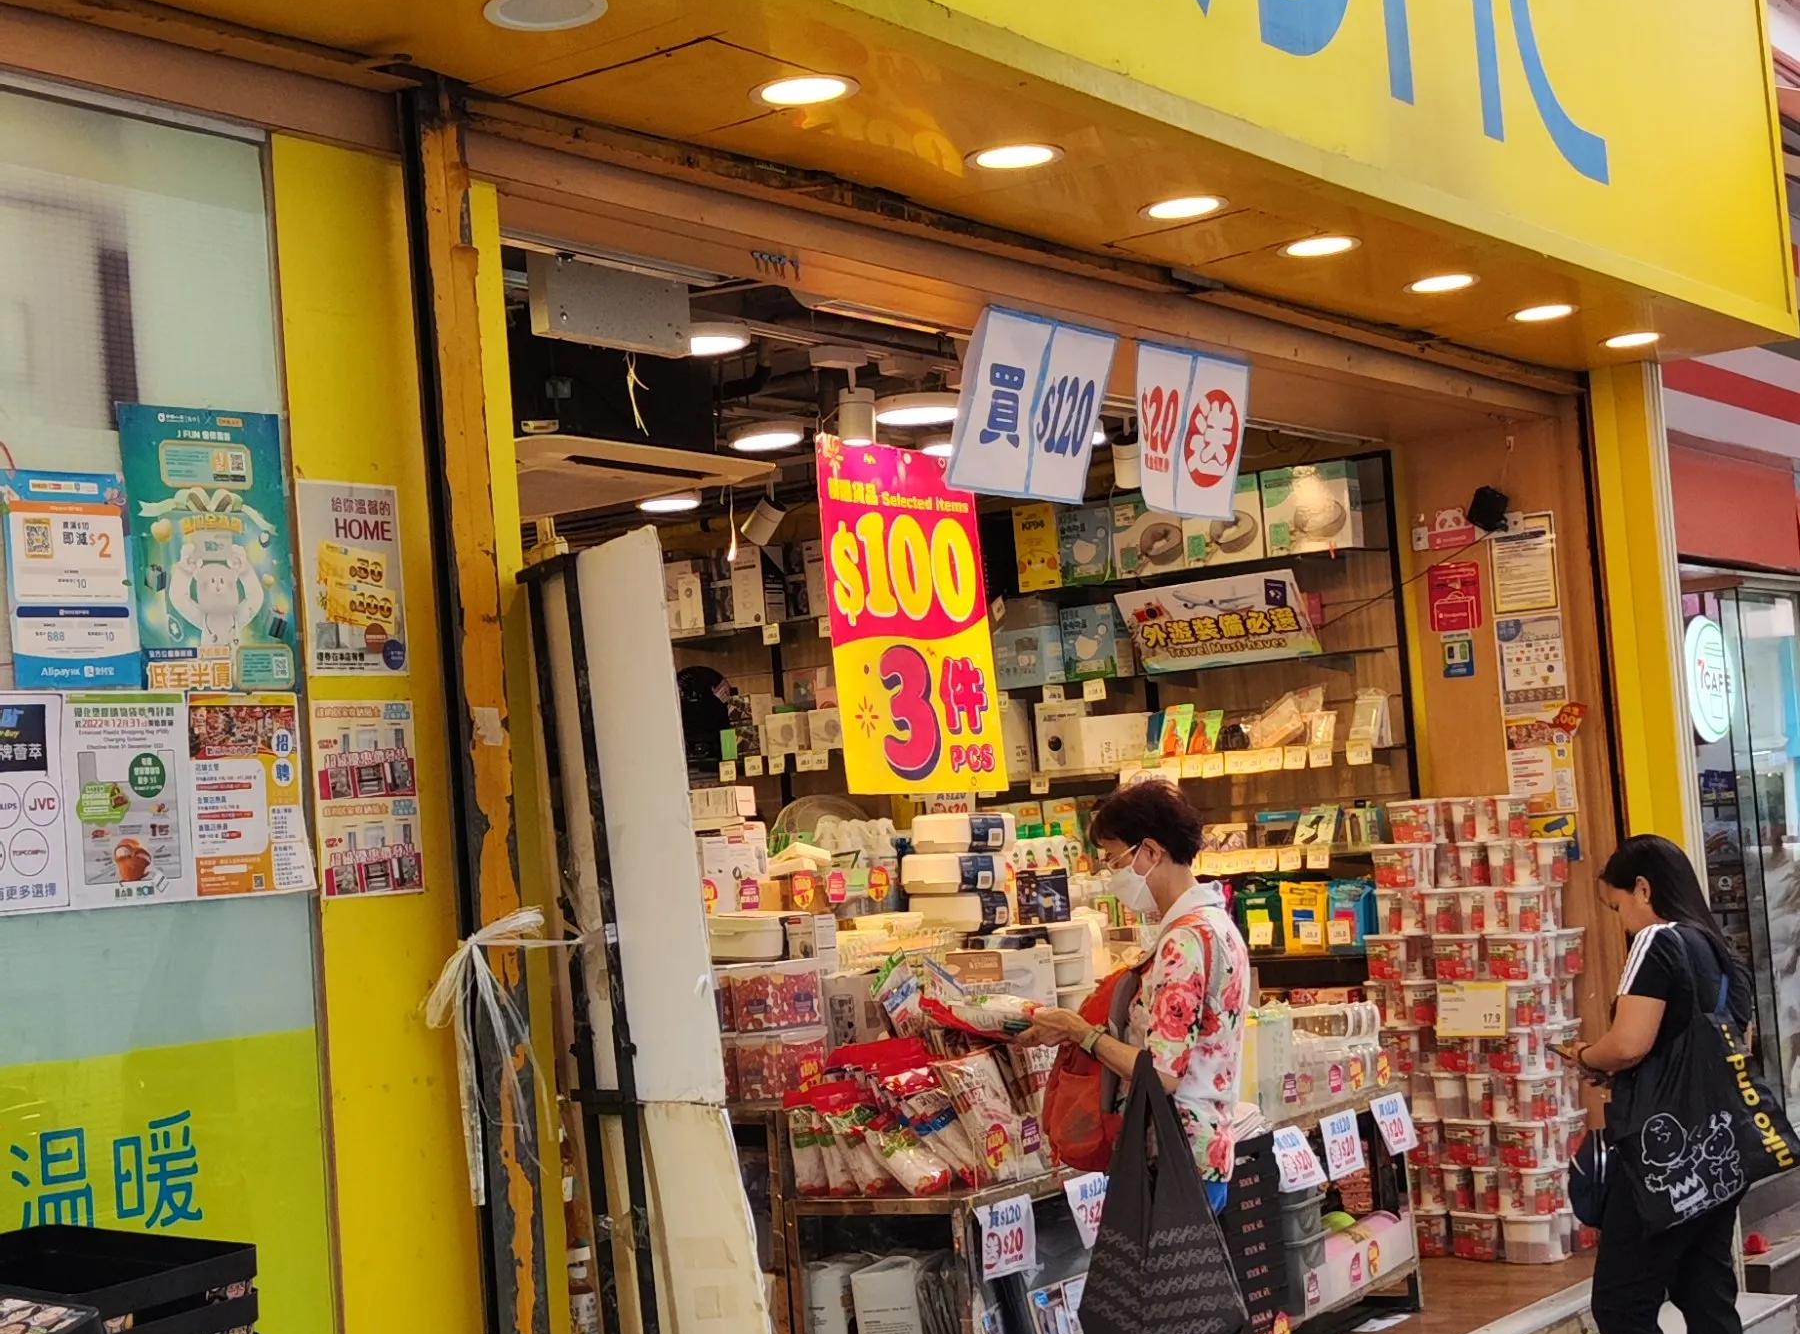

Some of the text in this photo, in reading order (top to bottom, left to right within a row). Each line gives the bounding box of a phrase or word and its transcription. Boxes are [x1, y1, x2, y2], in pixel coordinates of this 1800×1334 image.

[979, 362, 1095, 458] 買 $120
[1141, 385, 1234, 477] $20 送
[881, 491, 933, 511] Selected
[335, 517, 393, 542] HOME
[831, 511, 977, 627] $100
[1141, 605, 1302, 649] 外遊裝備必選
[1167, 642, 1208, 660] Travel
[950, 743, 996, 773] PCS
[29, 797, 56, 811] JVC
[1726, 1053, 1761, 1106] and
[1753, 1111, 1794, 1167] niko
[1089, 1201, 1103, 1224] $2
